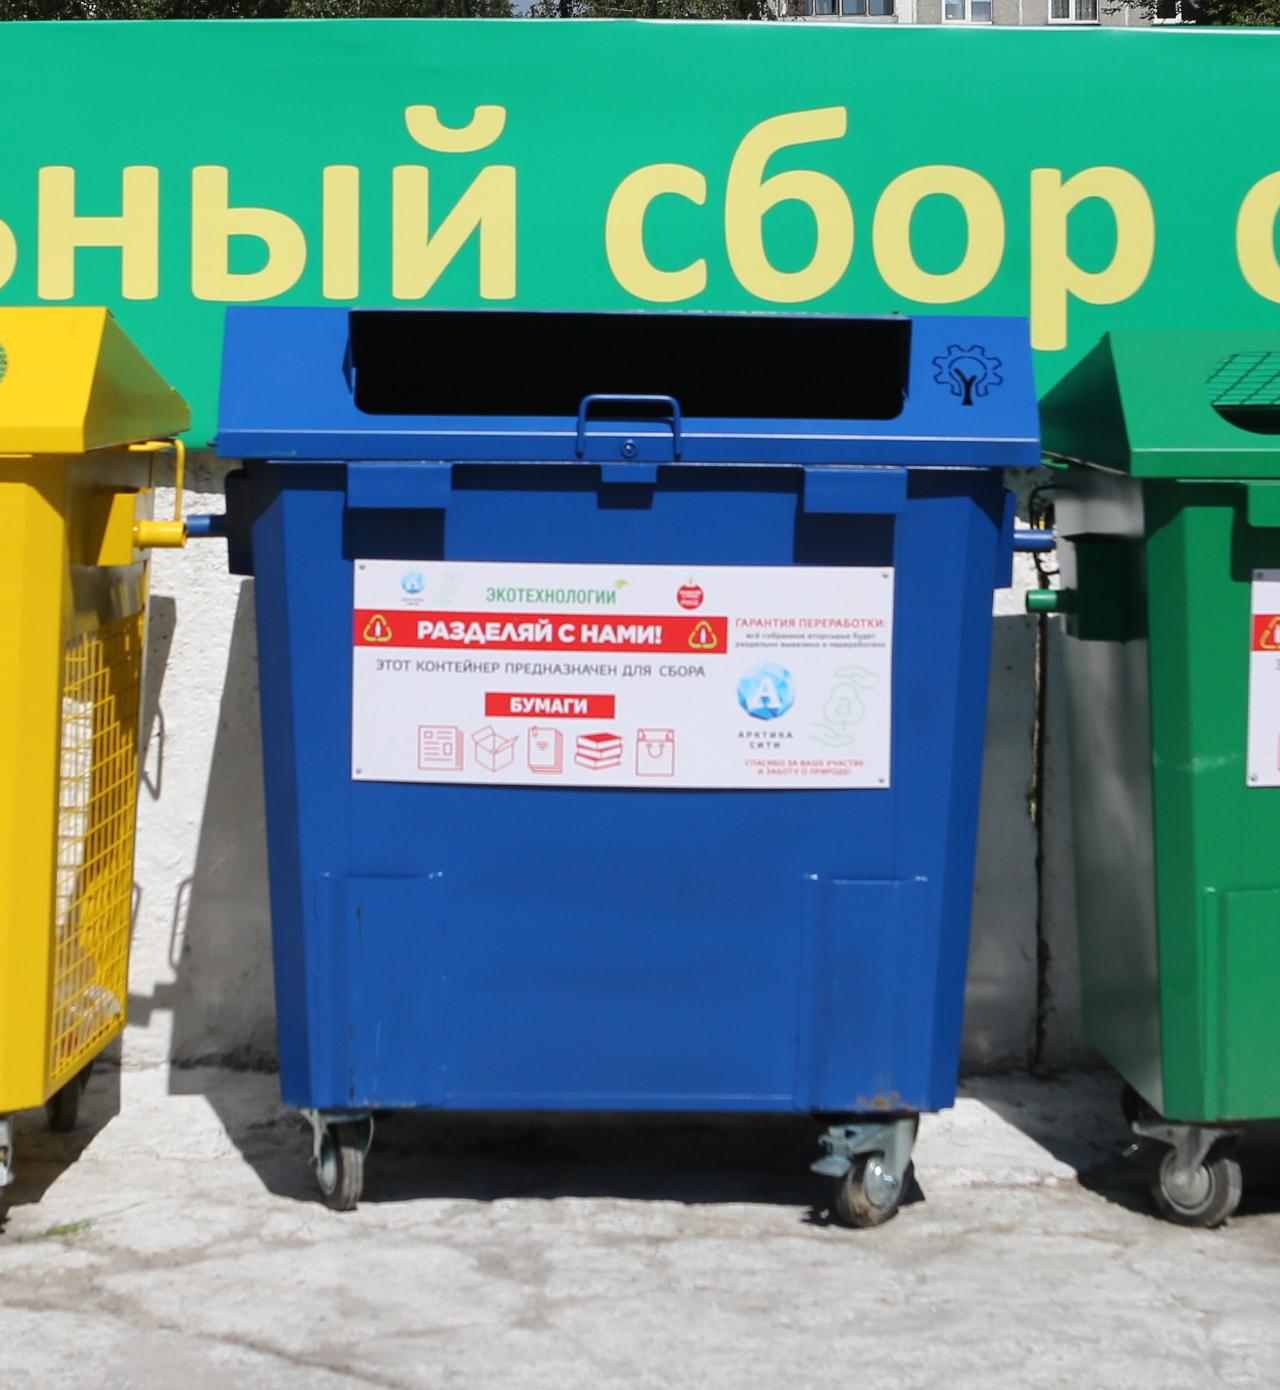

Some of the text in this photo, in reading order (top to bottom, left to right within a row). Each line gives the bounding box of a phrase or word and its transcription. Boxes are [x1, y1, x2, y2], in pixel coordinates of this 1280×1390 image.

[606, 105, 1156, 351] сбор
[486, 587, 616, 604] ЭКОТЕХНОЛОГИИ
[735, 618, 886, 628] ГАРАНТИЯ ПЕРЕРАБОТКИ:
[417, 619, 663, 645] РАЗДЕЛЯЙ С НАМИ!
[376, 658, 705, 678] ЭТОТ КОНТЕЙНЕР ПРЕДНАЗНАЧЕН ДЛЯ СБОРА
[510, 697, 588, 714] БУМАГИ
[738, 731, 793, 739] АРКТИКА
